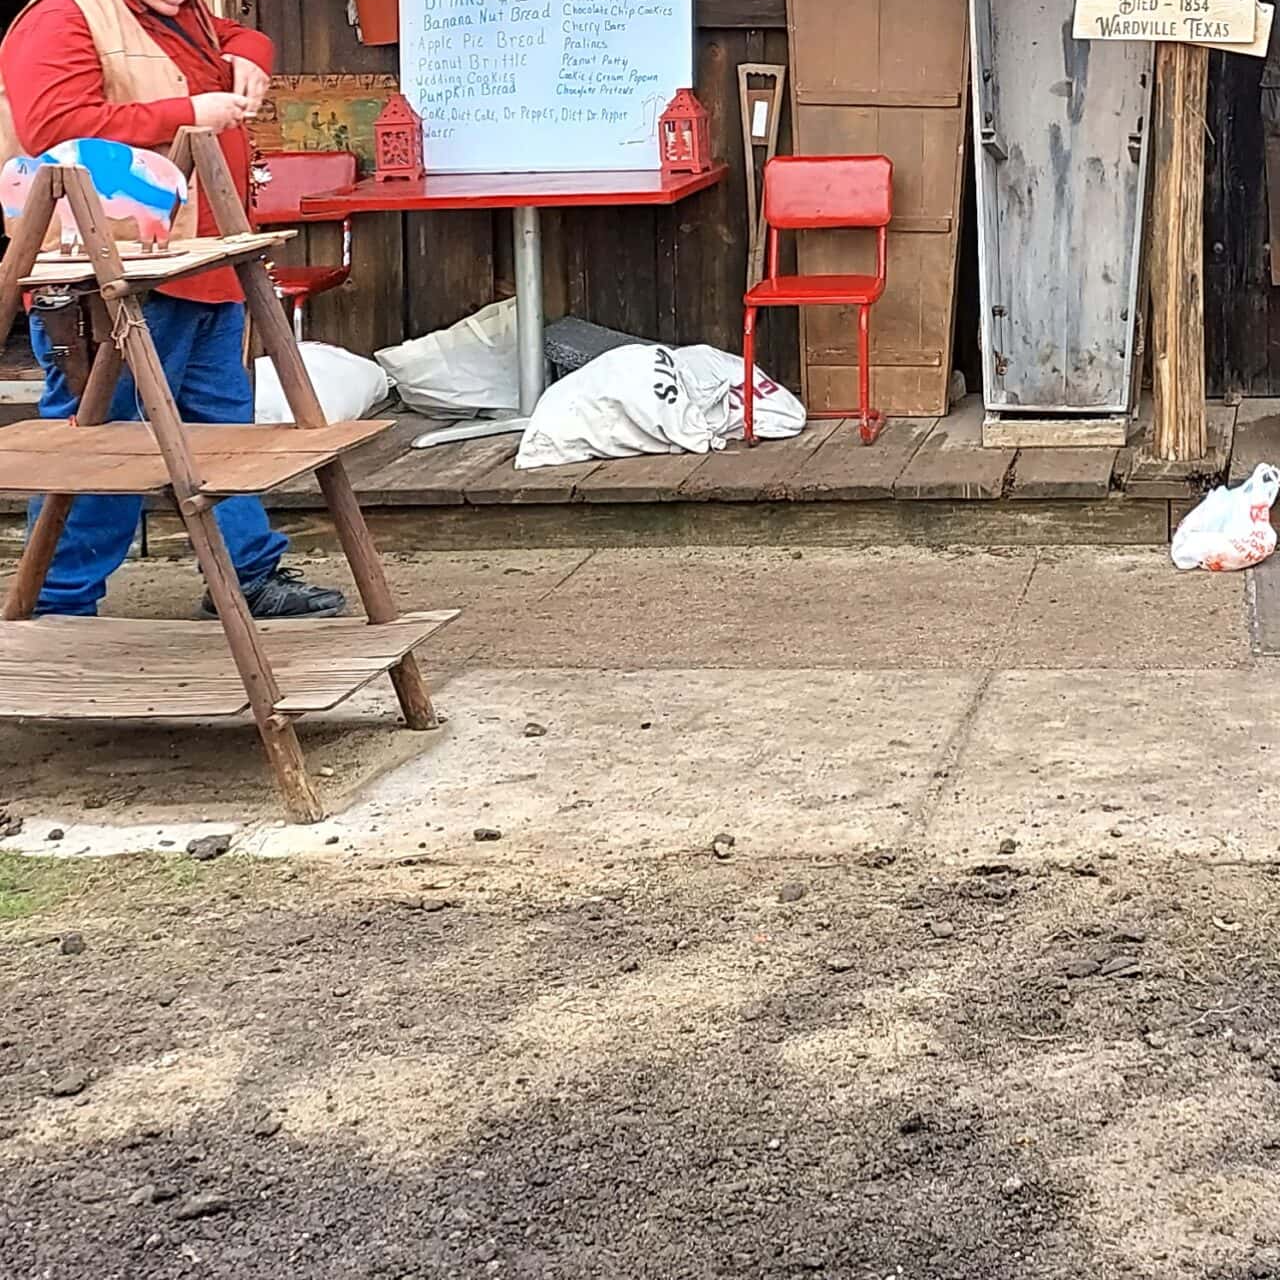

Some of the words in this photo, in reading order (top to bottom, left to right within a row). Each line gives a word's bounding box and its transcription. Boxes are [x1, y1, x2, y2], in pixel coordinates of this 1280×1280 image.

[424, 14, 474, 31] Banana
[479, 7, 504, 24] Nut
[511, 2, 552, 22] Bread
[562, 3, 608, 16] Chocolate
[610, 5, 635, 19] Chip
[562, 20, 600, 36] Cherry
[604, 20, 626, 32] Bars
[1095, 14, 1177, 38] WARDVILLE
[1183, 18, 1230, 39] TEXAS
[418, 35, 452, 55] Apple
[463, 32, 484, 49] Pie
[497, 28, 545, 48] Bread
[564, 37, 608, 50] Pralines
[418, 56, 462, 71] Peanut
[469, 53, 528, 70] Brittle
[562, 53, 596, 66] Peanut
[467, 71, 516, 84] Cookies
[481, 81, 517, 96] Bread
